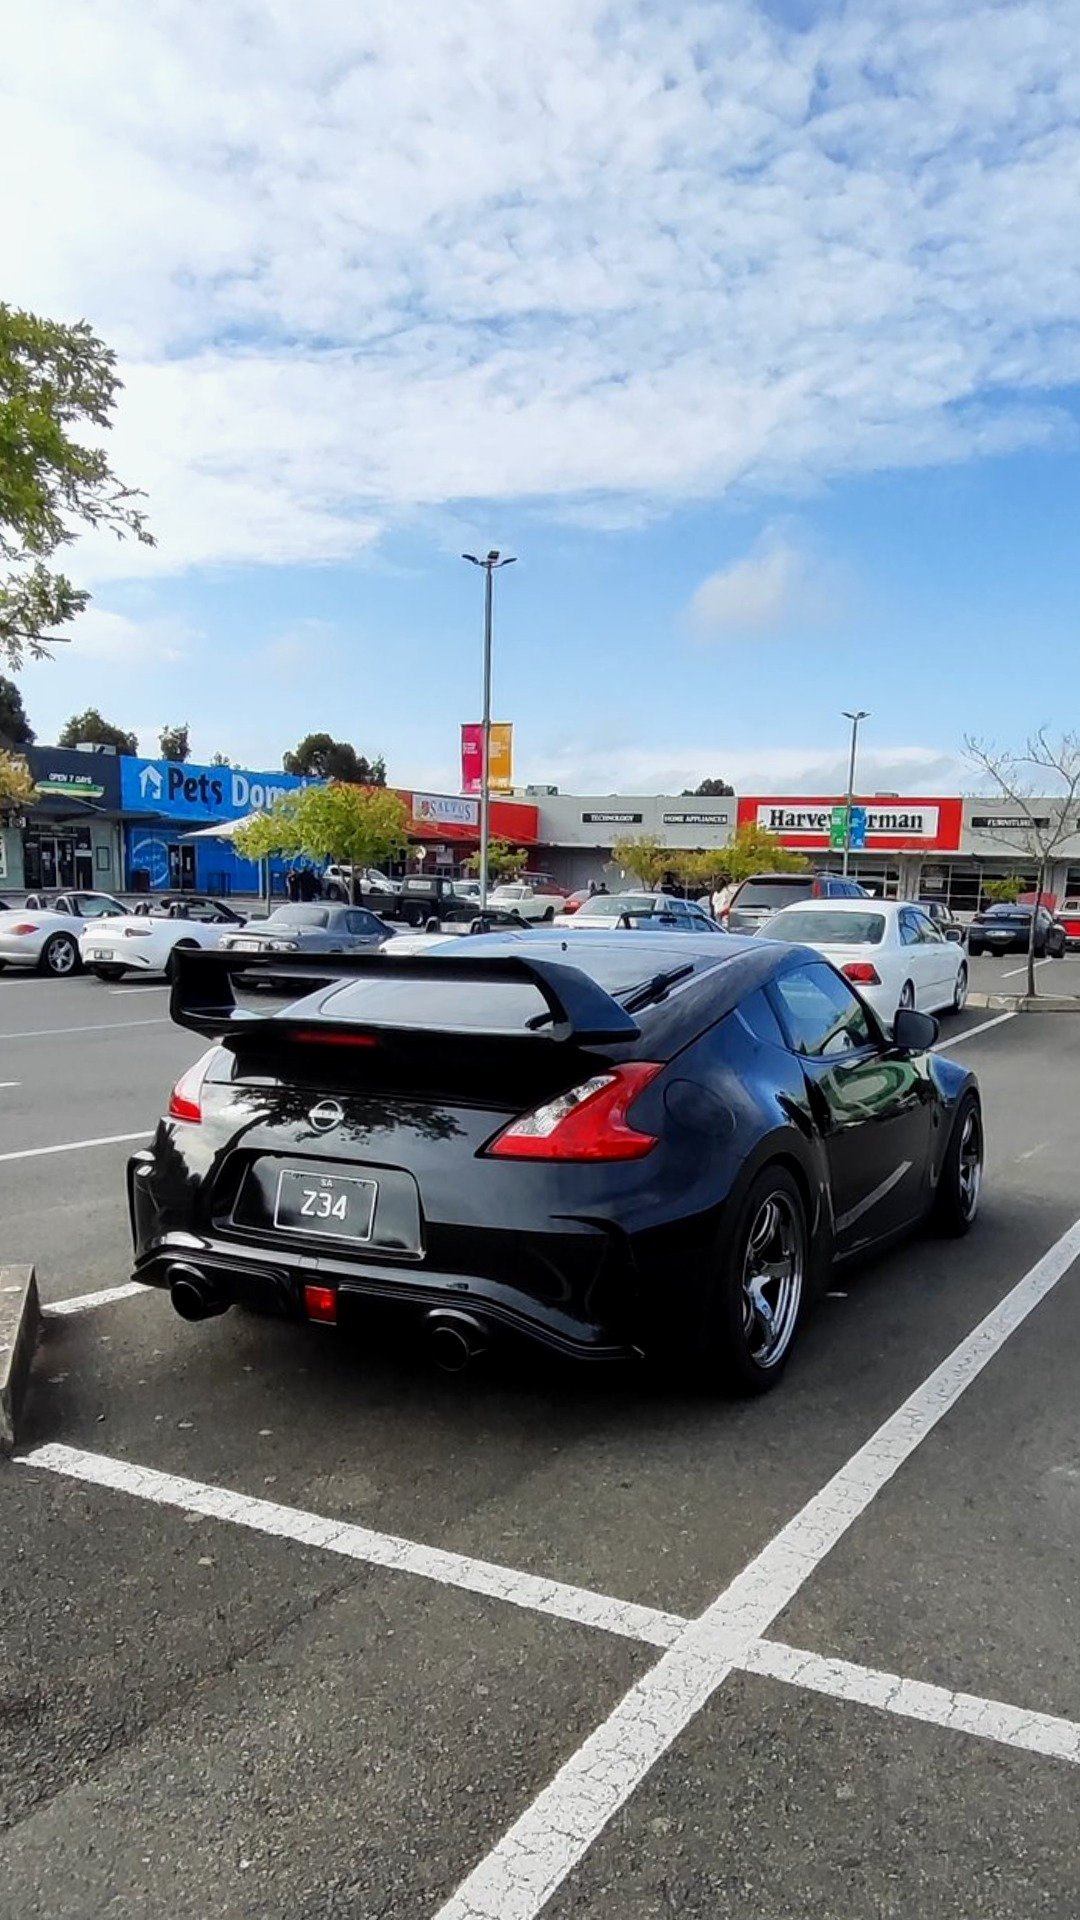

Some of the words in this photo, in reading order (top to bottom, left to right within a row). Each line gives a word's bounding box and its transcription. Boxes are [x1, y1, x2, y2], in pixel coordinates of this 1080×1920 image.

[48, 772, 68, 782] OPEN
[75, 775, 92, 785] DAYS
[168, 767, 223, 806] Pets
[231, 774, 308, 809] Dom
[591, 813, 634, 822] TECHNOLOGY
[664, 814, 684, 823] HOME
[685, 814, 727, 823] APPLIANCES
[769, 809, 833, 828] Harve
[866, 813, 923, 829] rman
[320, 1178, 333, 1188] SA
[300, 1189, 348, 1220] Z34
